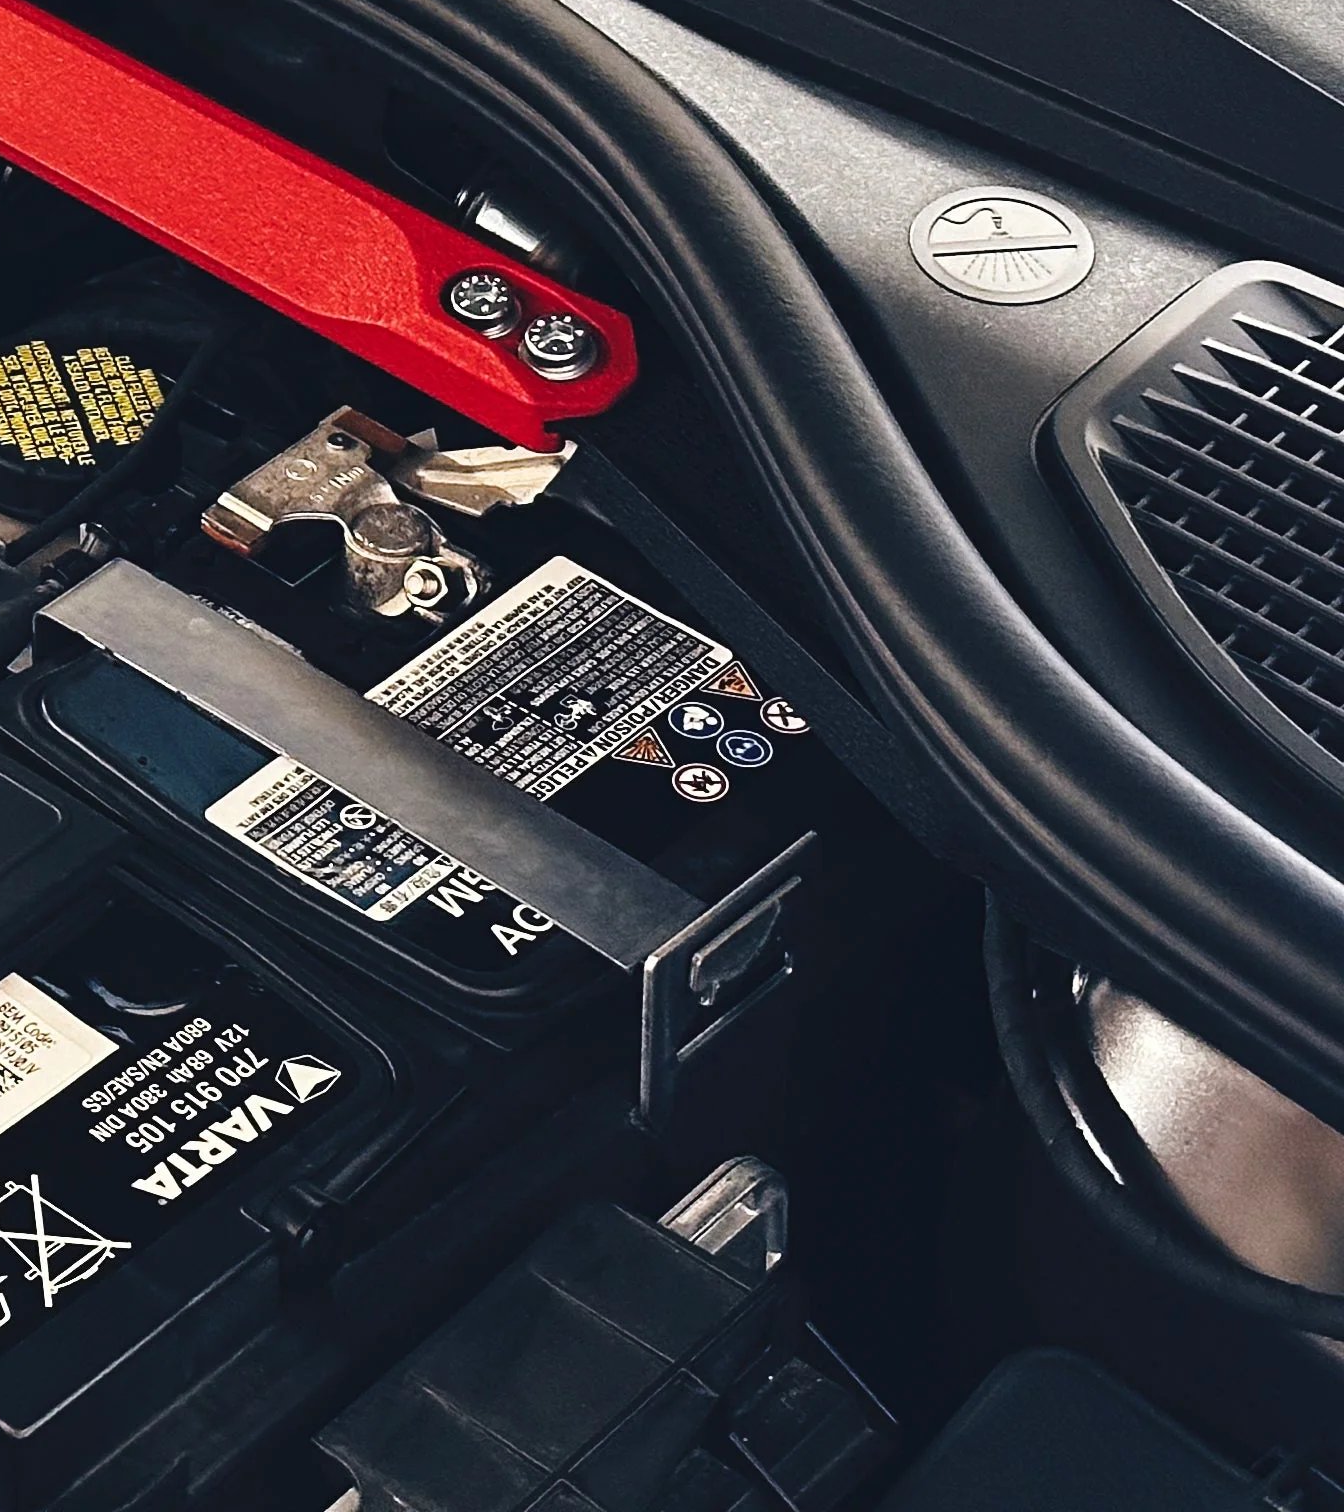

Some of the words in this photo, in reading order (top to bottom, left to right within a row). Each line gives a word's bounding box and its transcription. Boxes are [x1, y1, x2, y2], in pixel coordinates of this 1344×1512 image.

[526, 755, 589, 800] PELIGR
[490, 903, 555, 956] AG
[162, 1017, 212, 1052] 680A
[214, 1023, 250, 1053] 12V
[82, 1048, 171, 1113] EN/SAE/GS
[165, 1049, 214, 1084] 68Ah
[117, 1083, 168, 1119] 380A
[170, 1081, 223, 1120] 915
[88, 1114, 126, 1143] DIN
[125, 1115, 176, 1154] 105
[133, 1095, 293, 1204] VARTA
